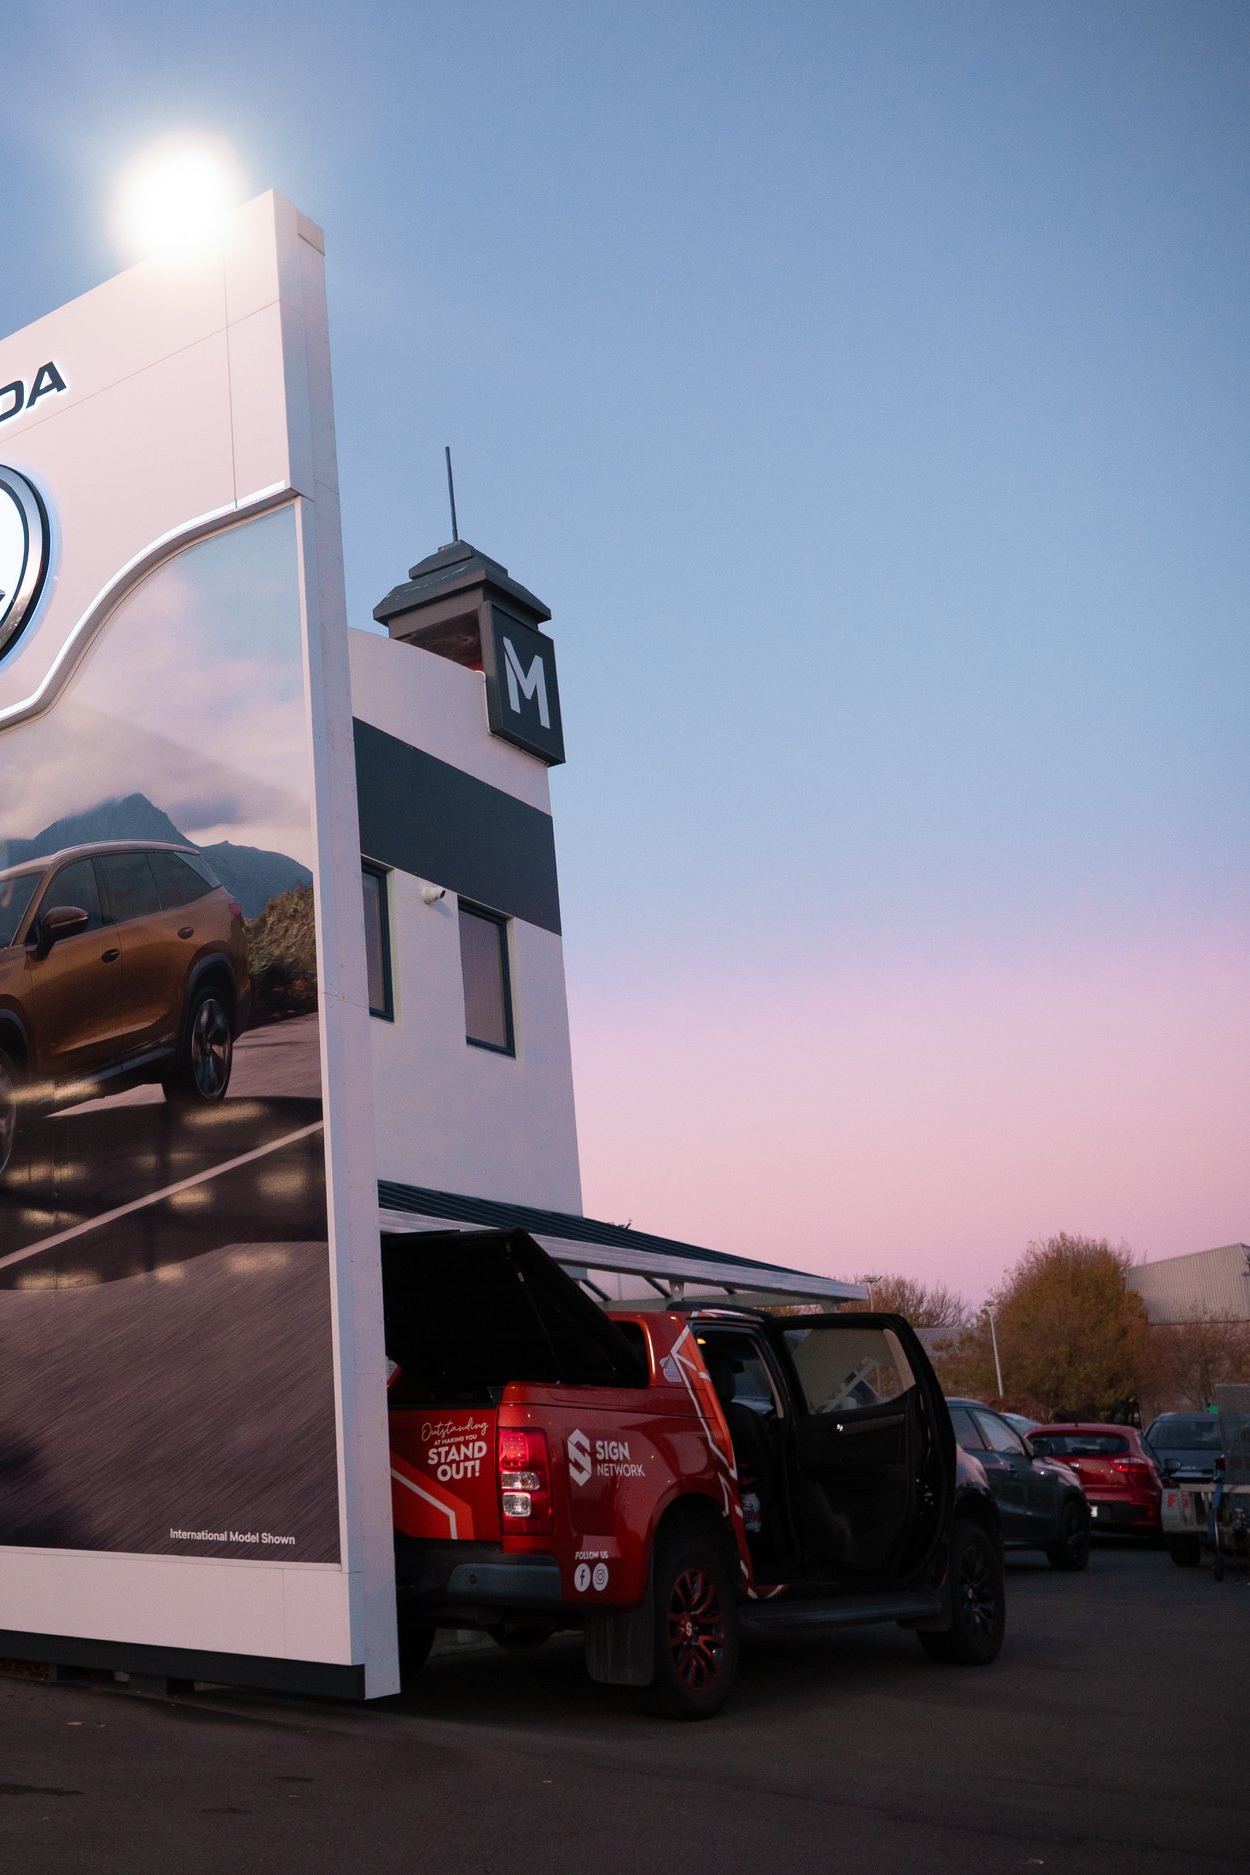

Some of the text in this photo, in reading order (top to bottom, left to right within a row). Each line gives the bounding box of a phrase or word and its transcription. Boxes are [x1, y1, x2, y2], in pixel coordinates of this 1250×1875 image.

[503, 636, 550, 729] M
[421, 1417, 489, 1441] Outstanding
[442, 1436, 464, 1444] MAKING
[427, 1441, 487, 1465] STAND
[596, 1441, 630, 1460] SIGN
[437, 1460, 480, 1482] OUT!
[597, 1463, 646, 1477] NETWORK
[170, 1528, 295, 1545] International Model Shown
[574, 1550, 609, 1560] FOLLOW US
